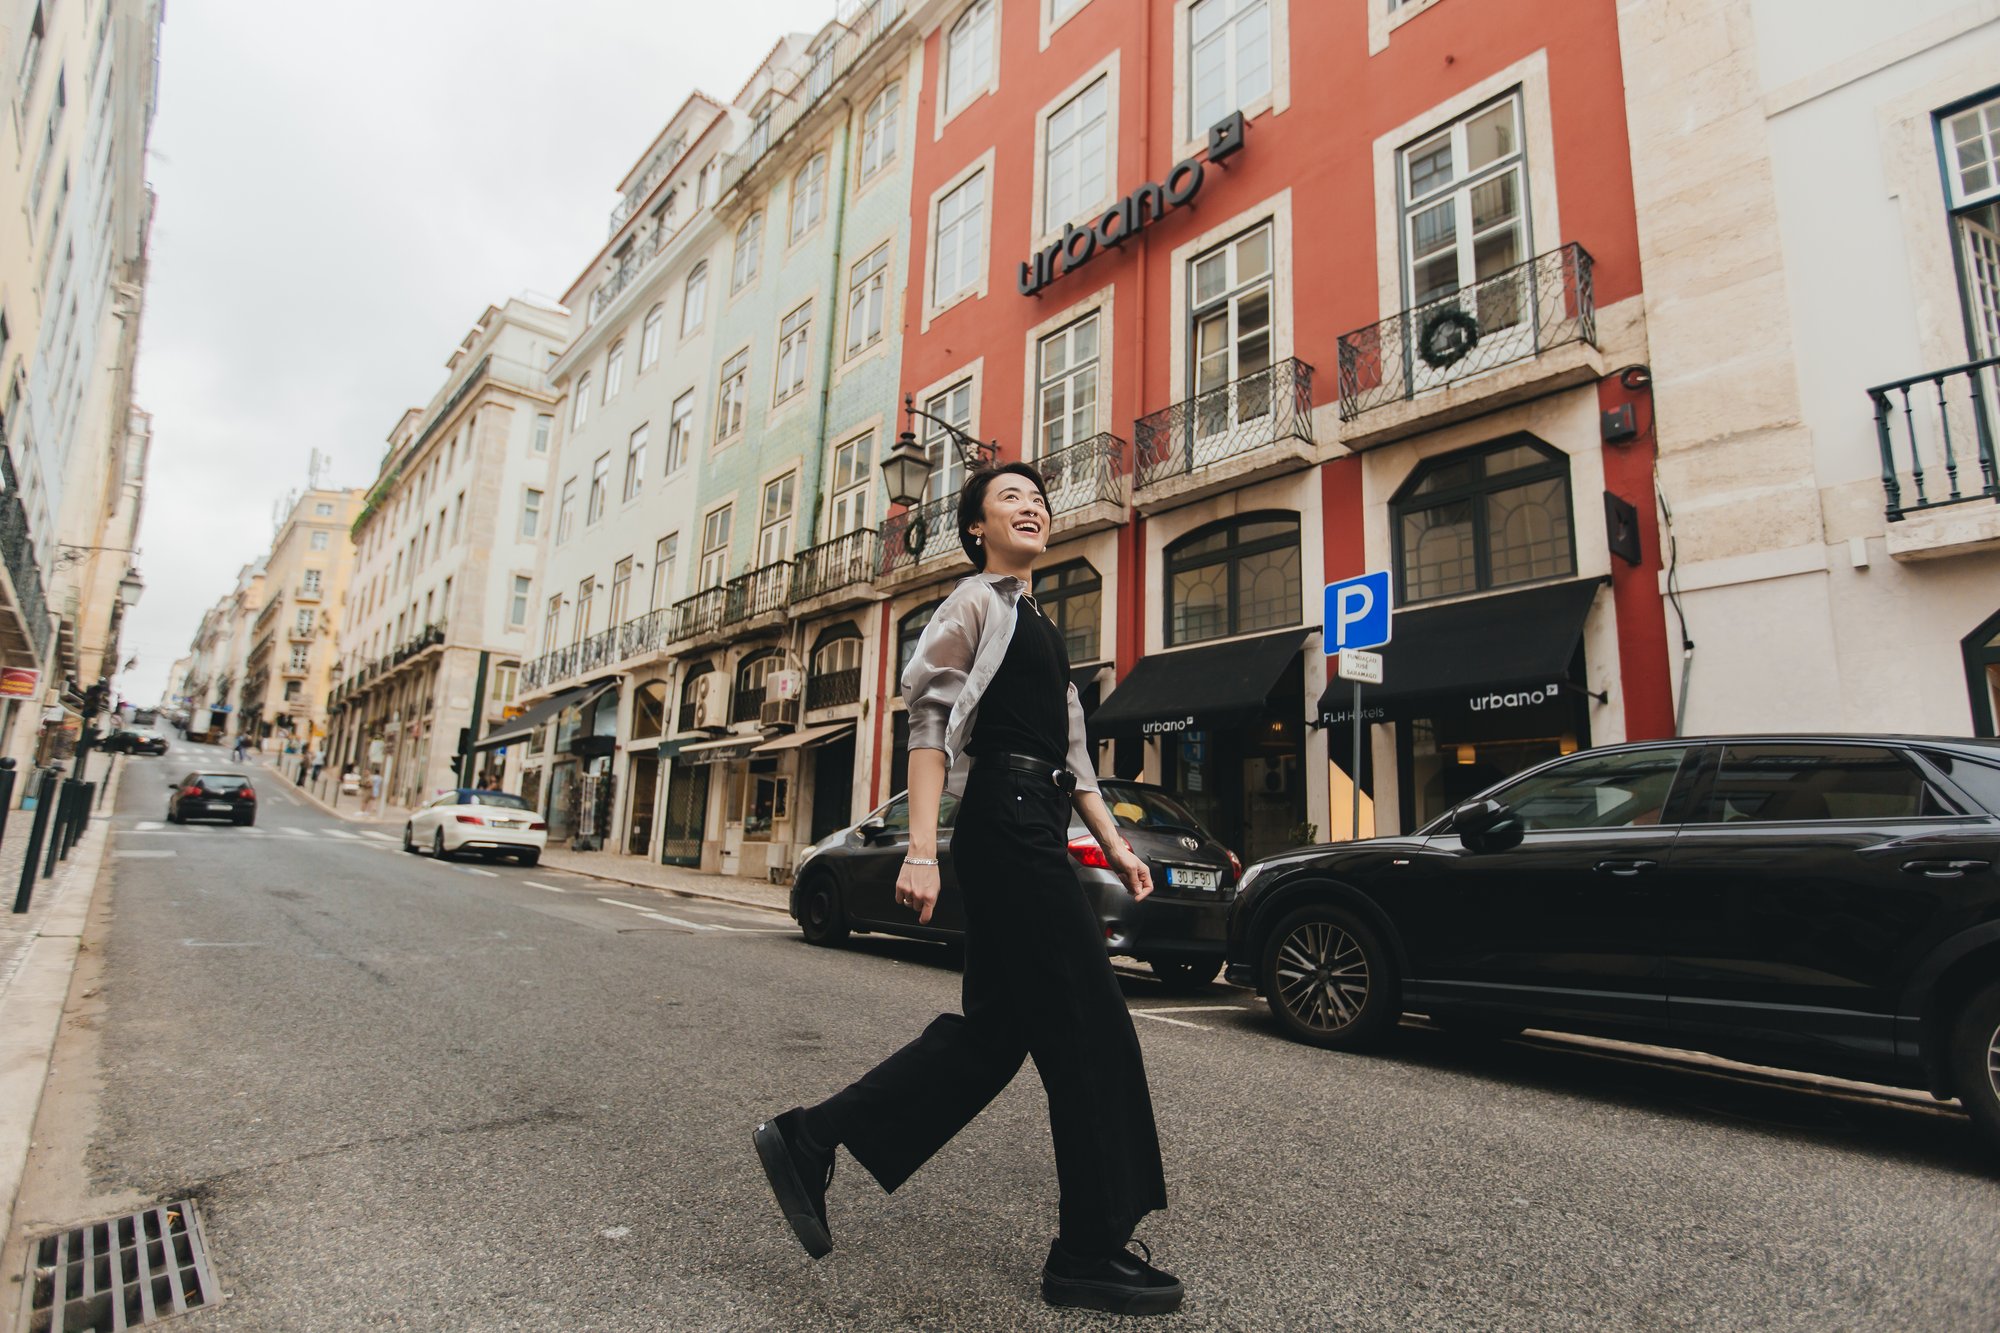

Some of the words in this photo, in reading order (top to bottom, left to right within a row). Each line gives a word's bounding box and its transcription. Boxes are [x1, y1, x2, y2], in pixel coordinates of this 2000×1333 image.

[1018, 158, 1204, 296] urbano
[1337, 584, 1374, 646] P
[1470, 691, 1544, 711] urbano
[1143, 720, 1186, 733] urbano
[1323, 711, 1345, 723] FLH
